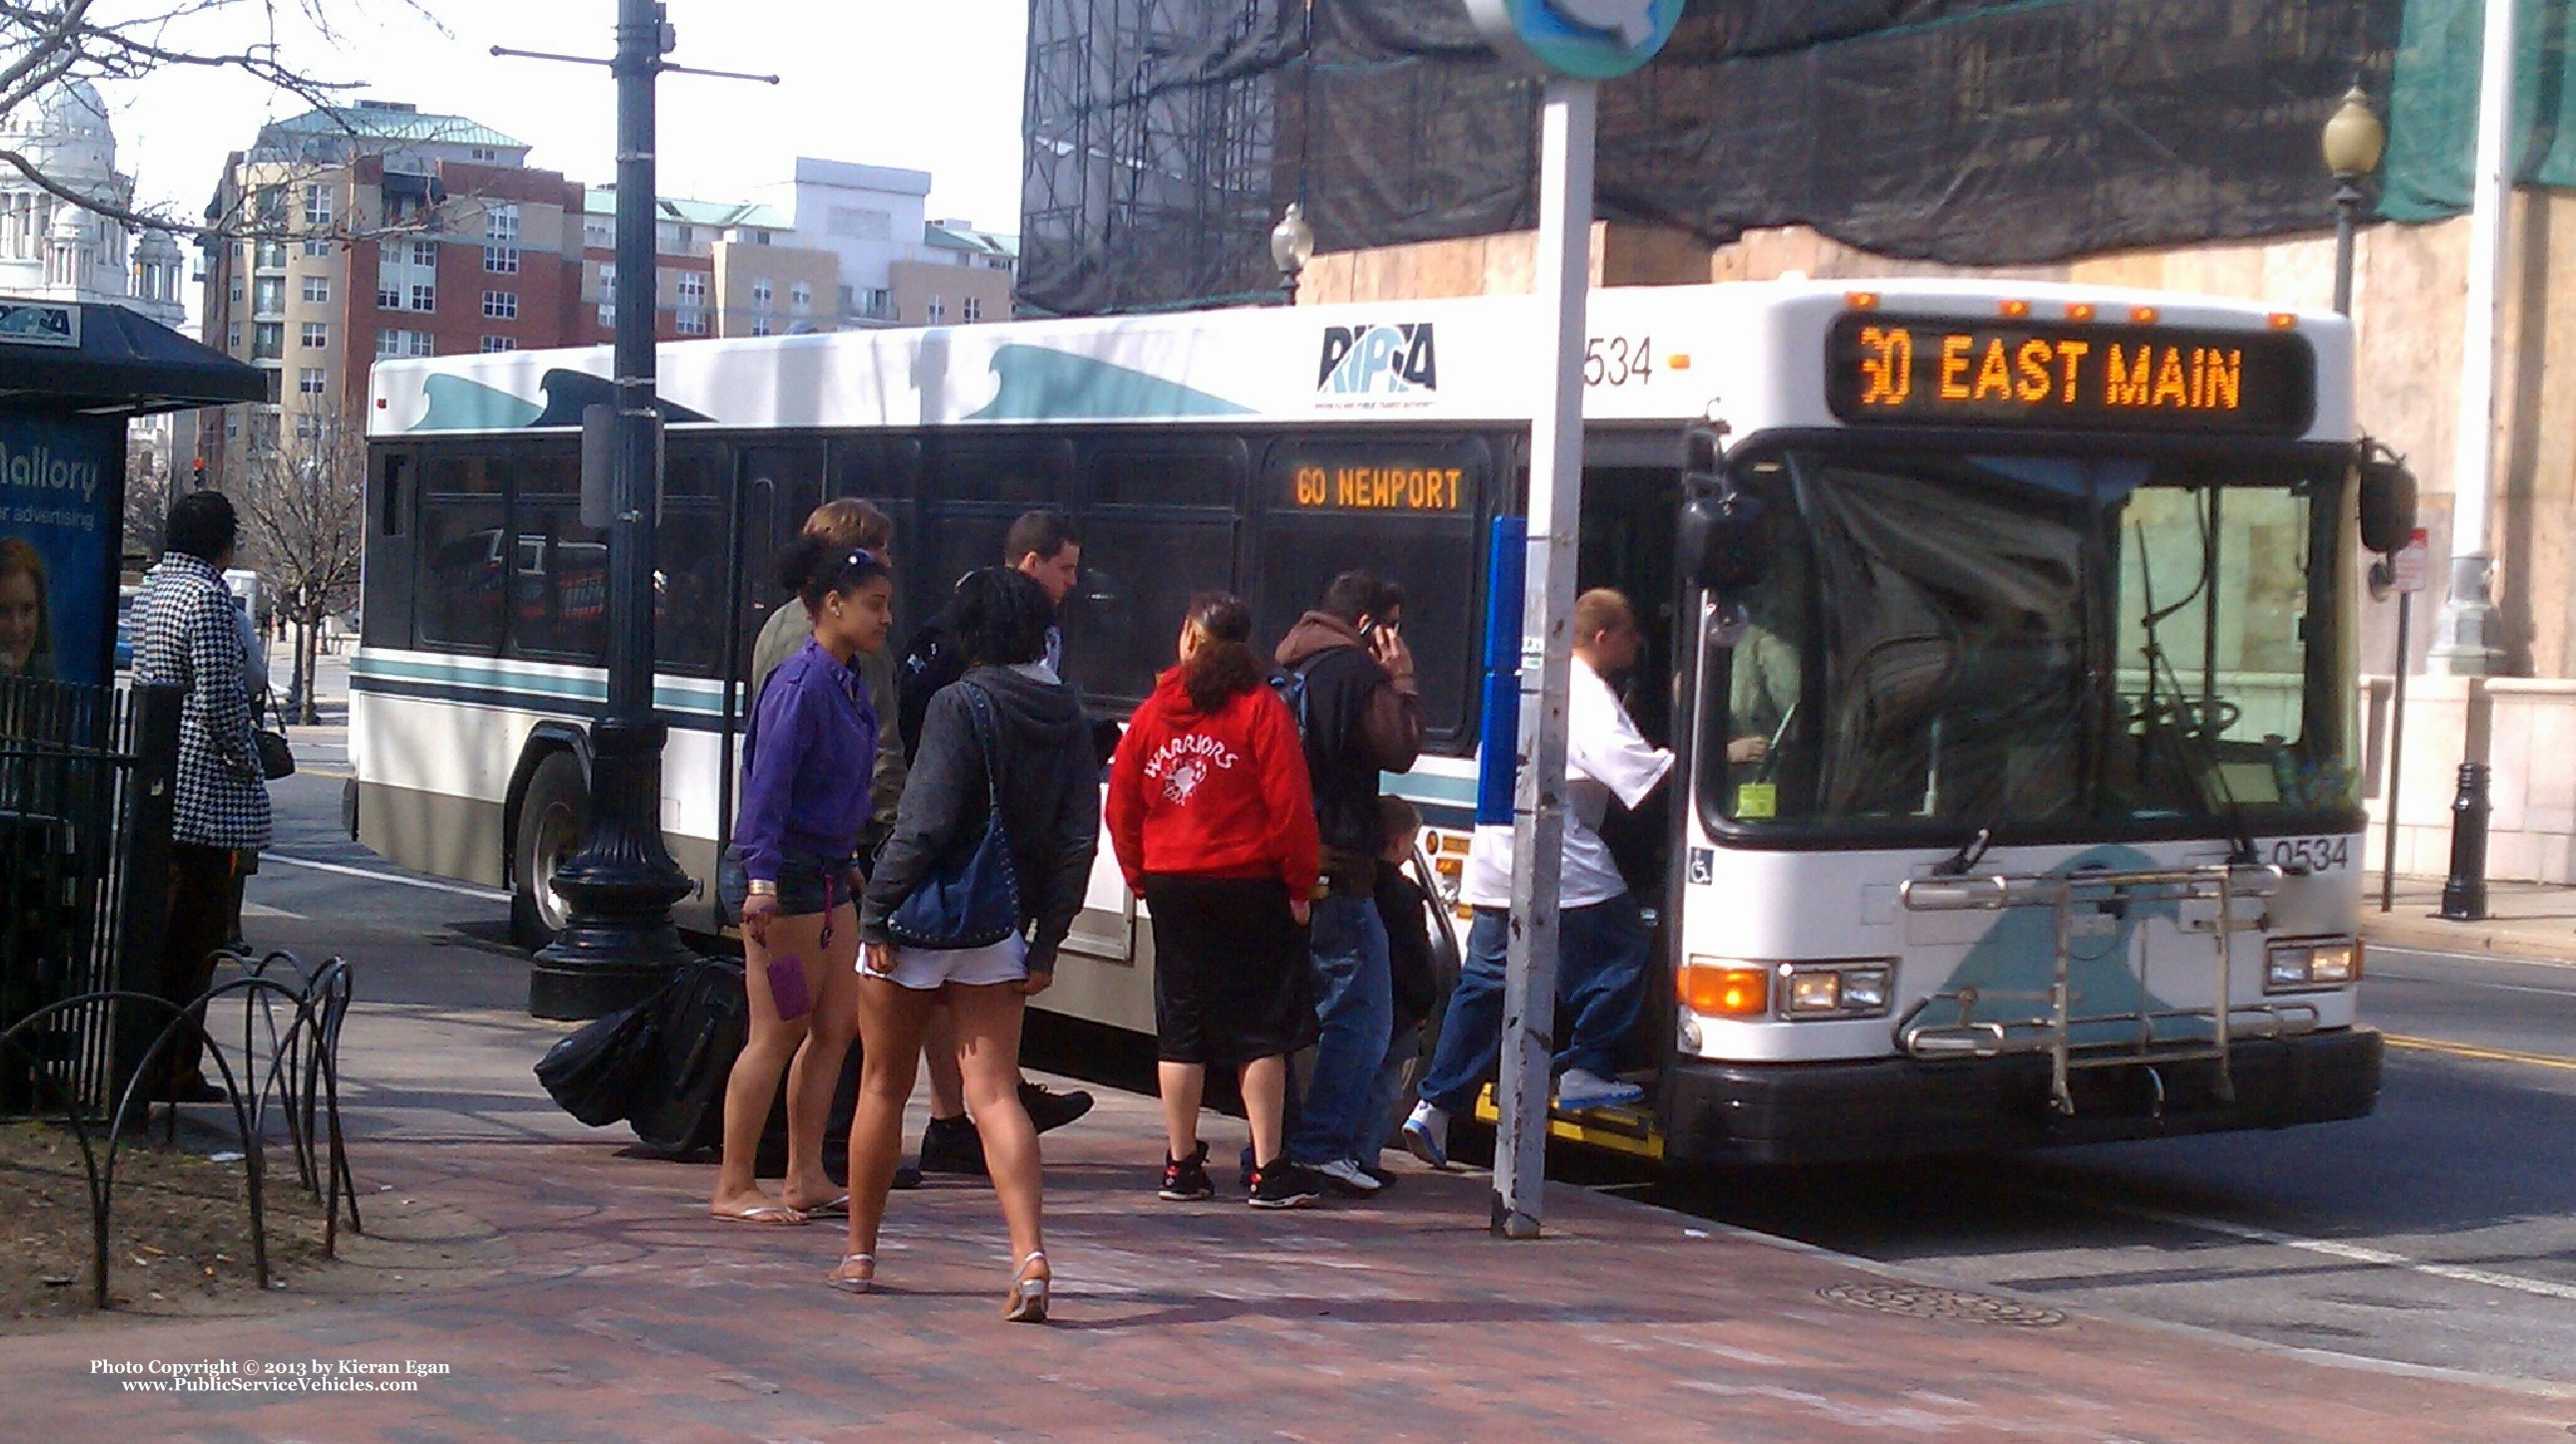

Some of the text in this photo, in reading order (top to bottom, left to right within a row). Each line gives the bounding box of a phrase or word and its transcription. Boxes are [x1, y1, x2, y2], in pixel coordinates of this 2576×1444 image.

[1317, 323, 1436, 392] RIPTA
[1941, 335, 2089, 402] EAST
[2106, 344, 2241, 408] MAIN
[1297, 467, 1461, 508] 60 NEWPORT
[1143, 734, 1239, 778] WARRIORS
[2273, 838, 2347, 871] 0534
